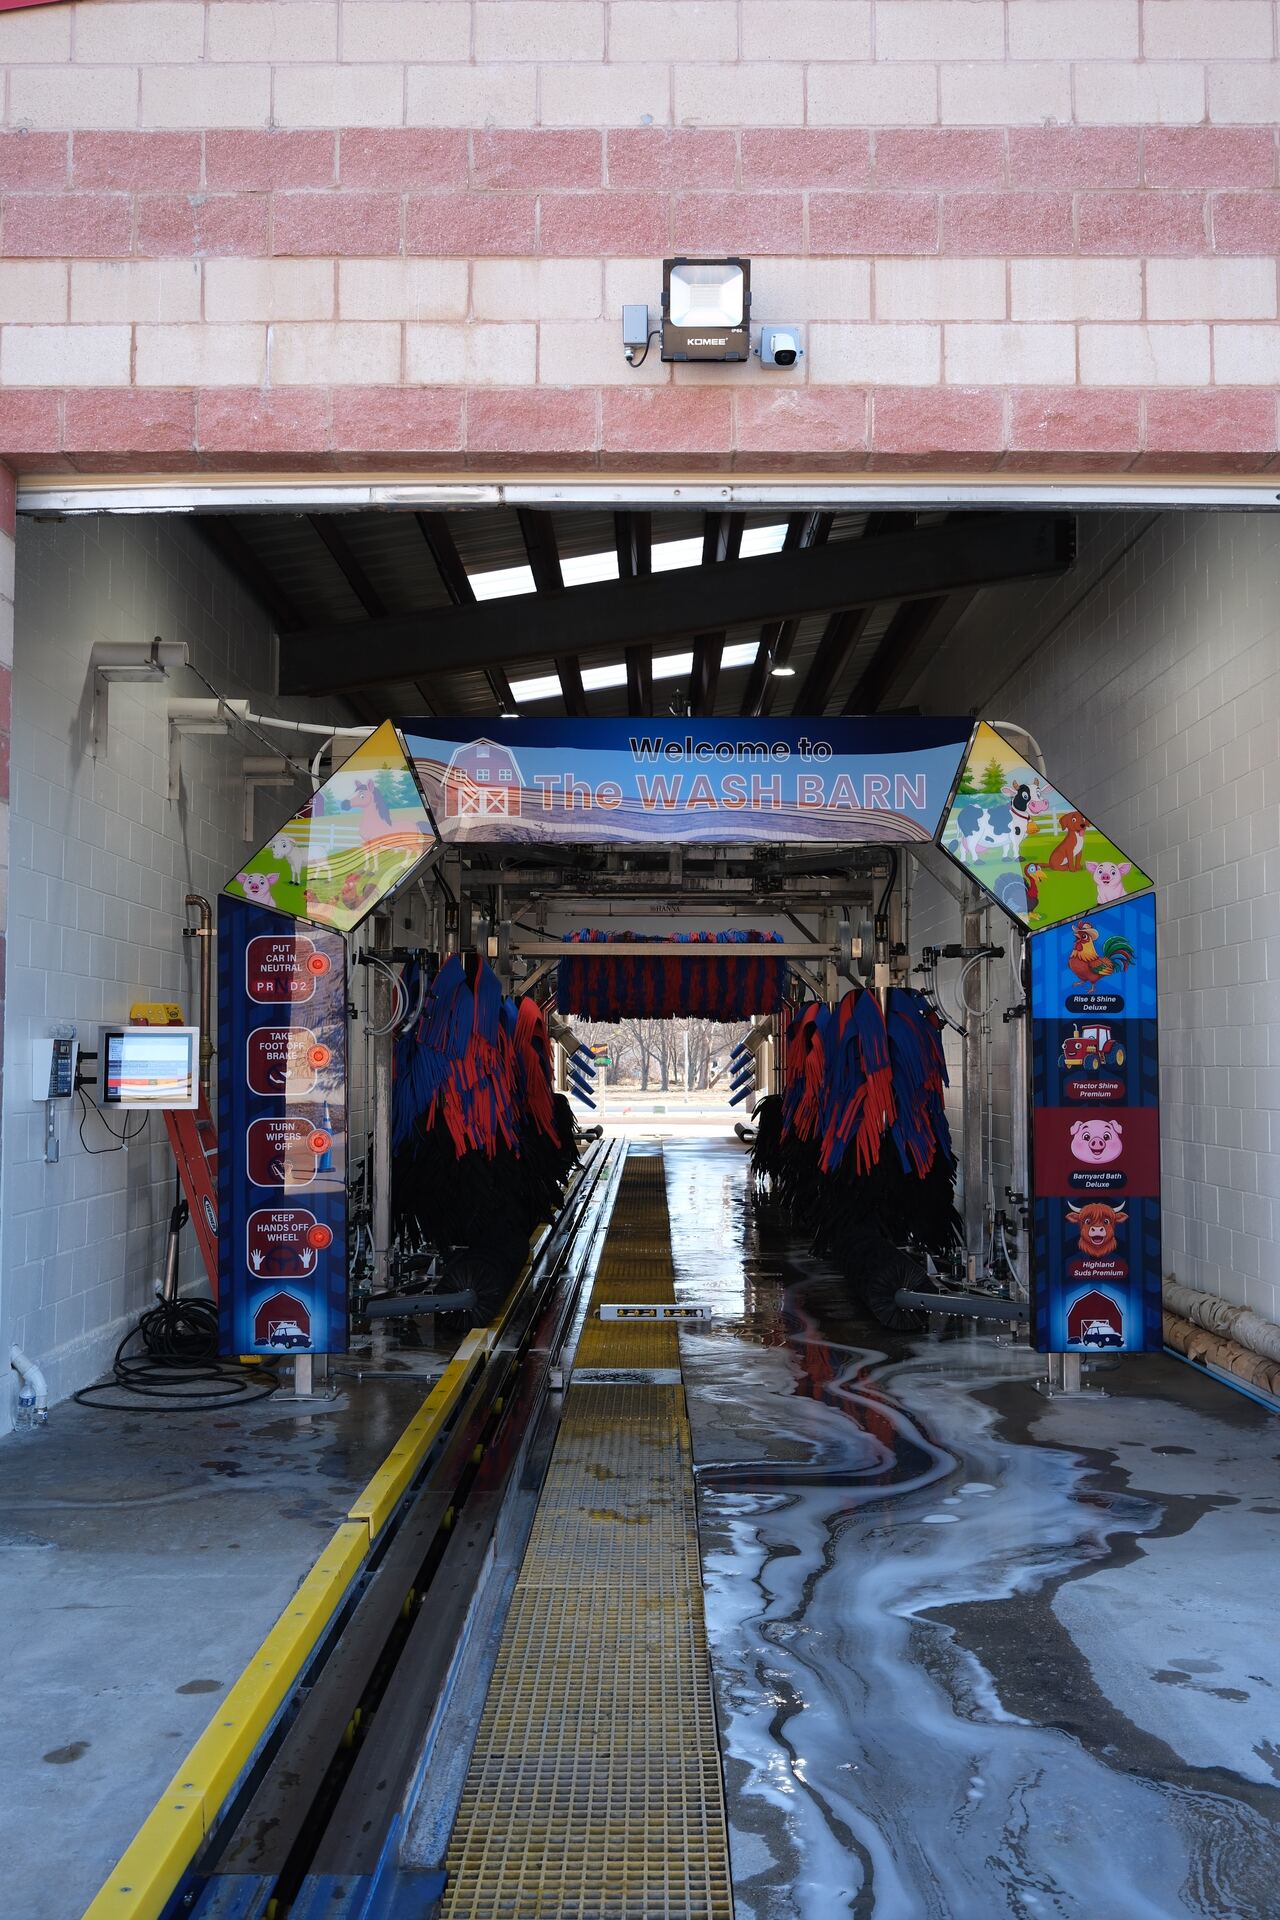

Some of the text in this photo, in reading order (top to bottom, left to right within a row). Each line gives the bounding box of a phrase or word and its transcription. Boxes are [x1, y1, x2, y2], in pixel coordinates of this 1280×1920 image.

[687, 338, 726, 346] KOMEE
[629, 736, 833, 763] Welcome to
[533, 773, 927, 811] The WASH BARN
[272, 944, 291, 953] PUT
[266, 954, 297, 963] CAR IN
[260, 964, 303, 973] NEUTRAL
[270, 1032, 293, 1041] TAKE
[259, 1042, 305, 1051] FOOT OFF
[266, 1052, 298, 1060] BRAKE
[269, 1123, 295, 1131] TURN
[265, 1132, 302, 1141] WIPERS
[274, 1142, 293, 1151] OFF
[1073, 1173, 1105, 1181] Barnyard
[271, 1214, 295, 1222] KEEP
[257, 1223, 309, 1232] HANDS OFF
[267, 1233, 300, 1241] WHEEL
[1082, 1261, 1115, 1269] Highland
